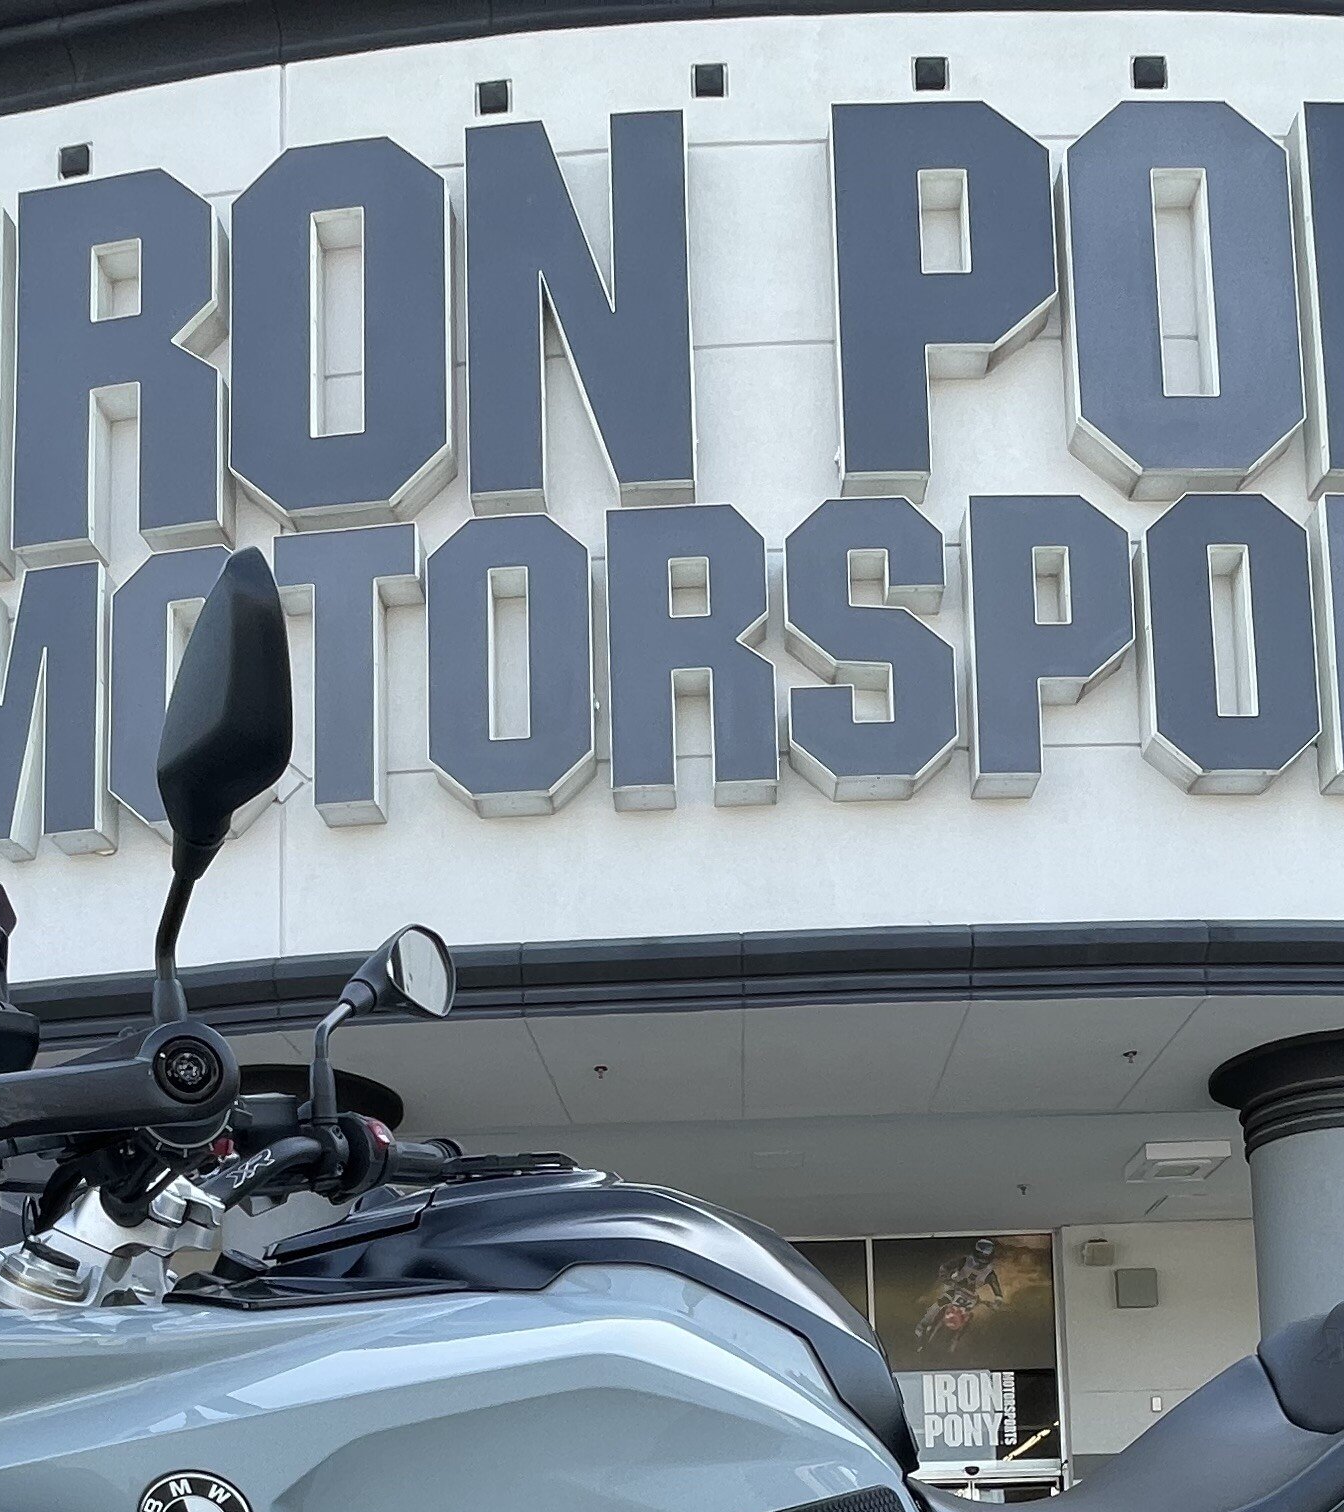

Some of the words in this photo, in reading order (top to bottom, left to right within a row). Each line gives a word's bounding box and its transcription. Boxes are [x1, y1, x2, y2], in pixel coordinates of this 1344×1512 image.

[922, 1372, 1003, 1412] IRON
[1003, 1371, 1017, 1446] MOTORSPORTS
[925, 1414, 1002, 1447] PONY
